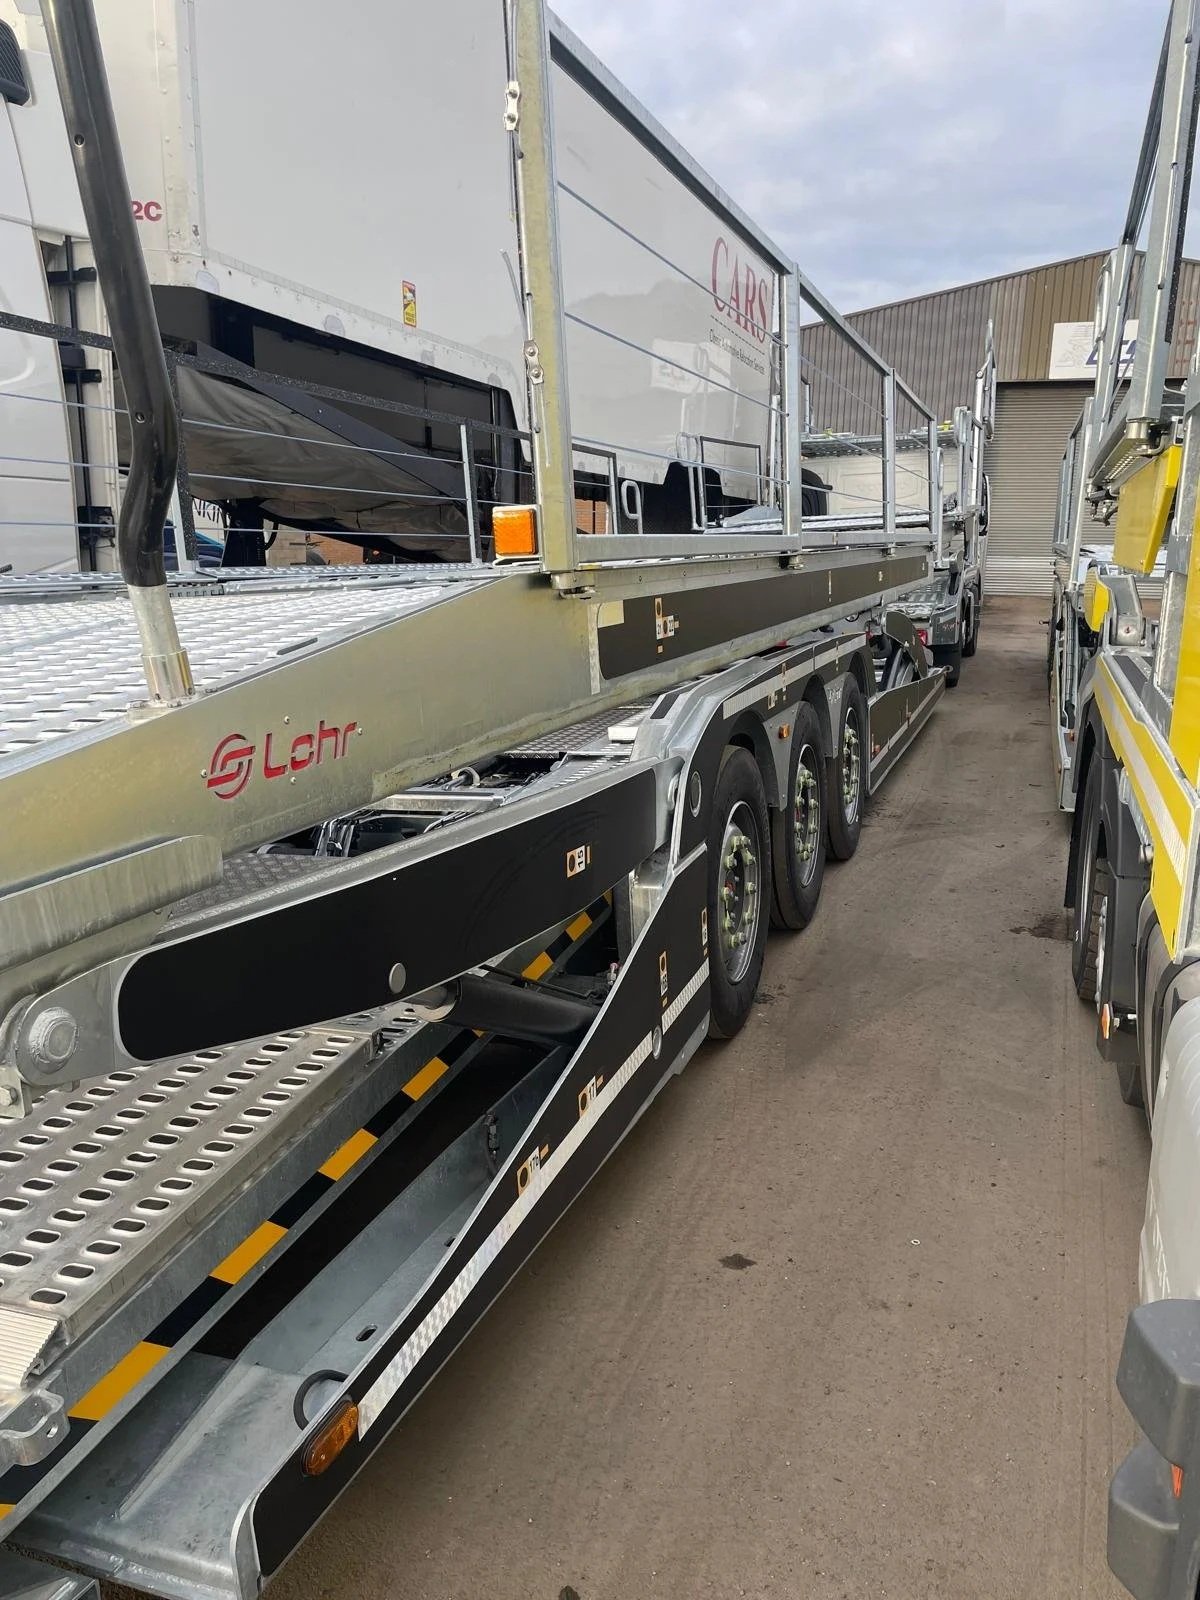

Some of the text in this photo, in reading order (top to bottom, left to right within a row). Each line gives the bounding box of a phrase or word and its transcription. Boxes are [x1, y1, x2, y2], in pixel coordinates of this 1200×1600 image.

[711, 236, 768, 344] CARS
[263, 720, 358, 779] Lohr
[577, 849, 584, 868] 15
